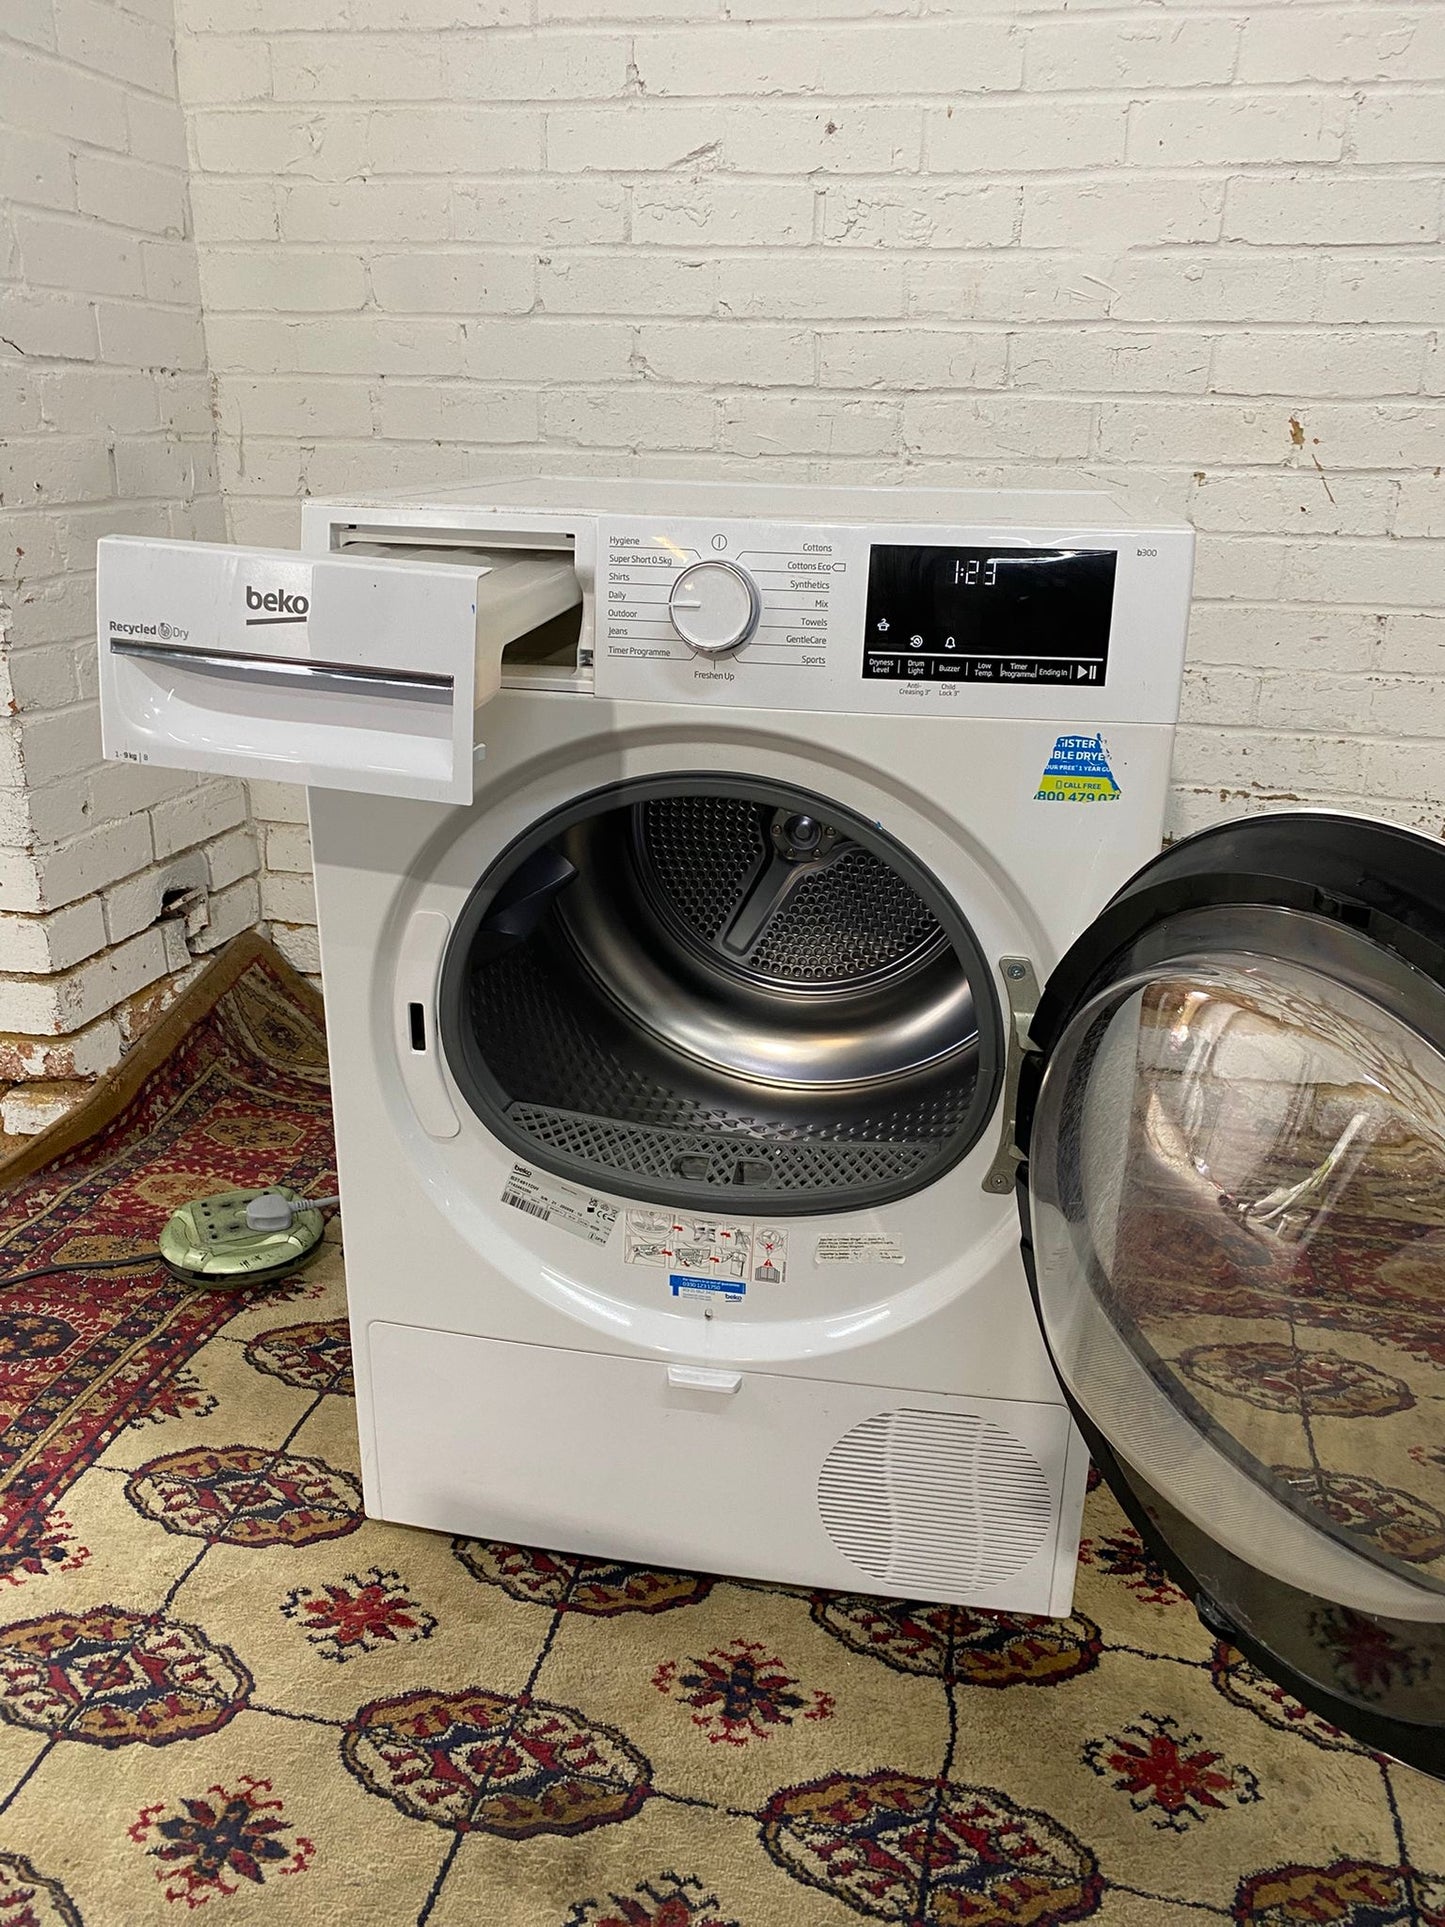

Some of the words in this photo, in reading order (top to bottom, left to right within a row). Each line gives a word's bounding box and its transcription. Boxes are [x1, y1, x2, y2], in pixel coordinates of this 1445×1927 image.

[609, 536, 640, 546] Hygiene
[802, 543, 833, 552] Cottons
[1136, 549, 1158, 557] b300
[609, 554, 631, 564] Super
[631, 555, 651, 564] Short
[652, 556, 673, 566] 0.5kg
[787, 561, 817, 570] Cottons
[817, 562, 832, 571] Eco
[608, 572, 630, 581] Shirts
[954, 559, 997, 585] 1:23
[790, 579, 830, 590] Synthetics
[246, 585, 309, 614] beko
[608, 590, 626, 600] Daily
[815, 599, 829, 608] Mix
[608, 609, 638, 618] Outdoor
[800, 617, 828, 626] Towels
[109, 621, 157, 635] Recycled
[173, 626, 190, 641] Dry
[608, 627, 628, 636] Jeans
[786, 635, 827, 644] GentleCare
[608, 646, 629, 655] Timer
[629, 647, 671, 657] Programme
[801, 655, 826, 665] Sports
[869, 658, 894, 667] Dryness
[938, 664, 961, 672] Buzzer
[1010, 662, 1028, 670] Timer
[694, 670, 723, 680] Freshen
[724, 672, 735, 681] Up
[907, 667, 924, 676] Light
[974, 669, 993, 677] Temp.
[1002, 669, 1035, 678] Programme
[1039, 668, 1060, 677] Ending
[898, 687, 924, 696] Creasing
[1051, 750, 1075, 760] BLE
[1033, 790, 1065, 801] 800
[514, 1164, 532, 1176] beko
